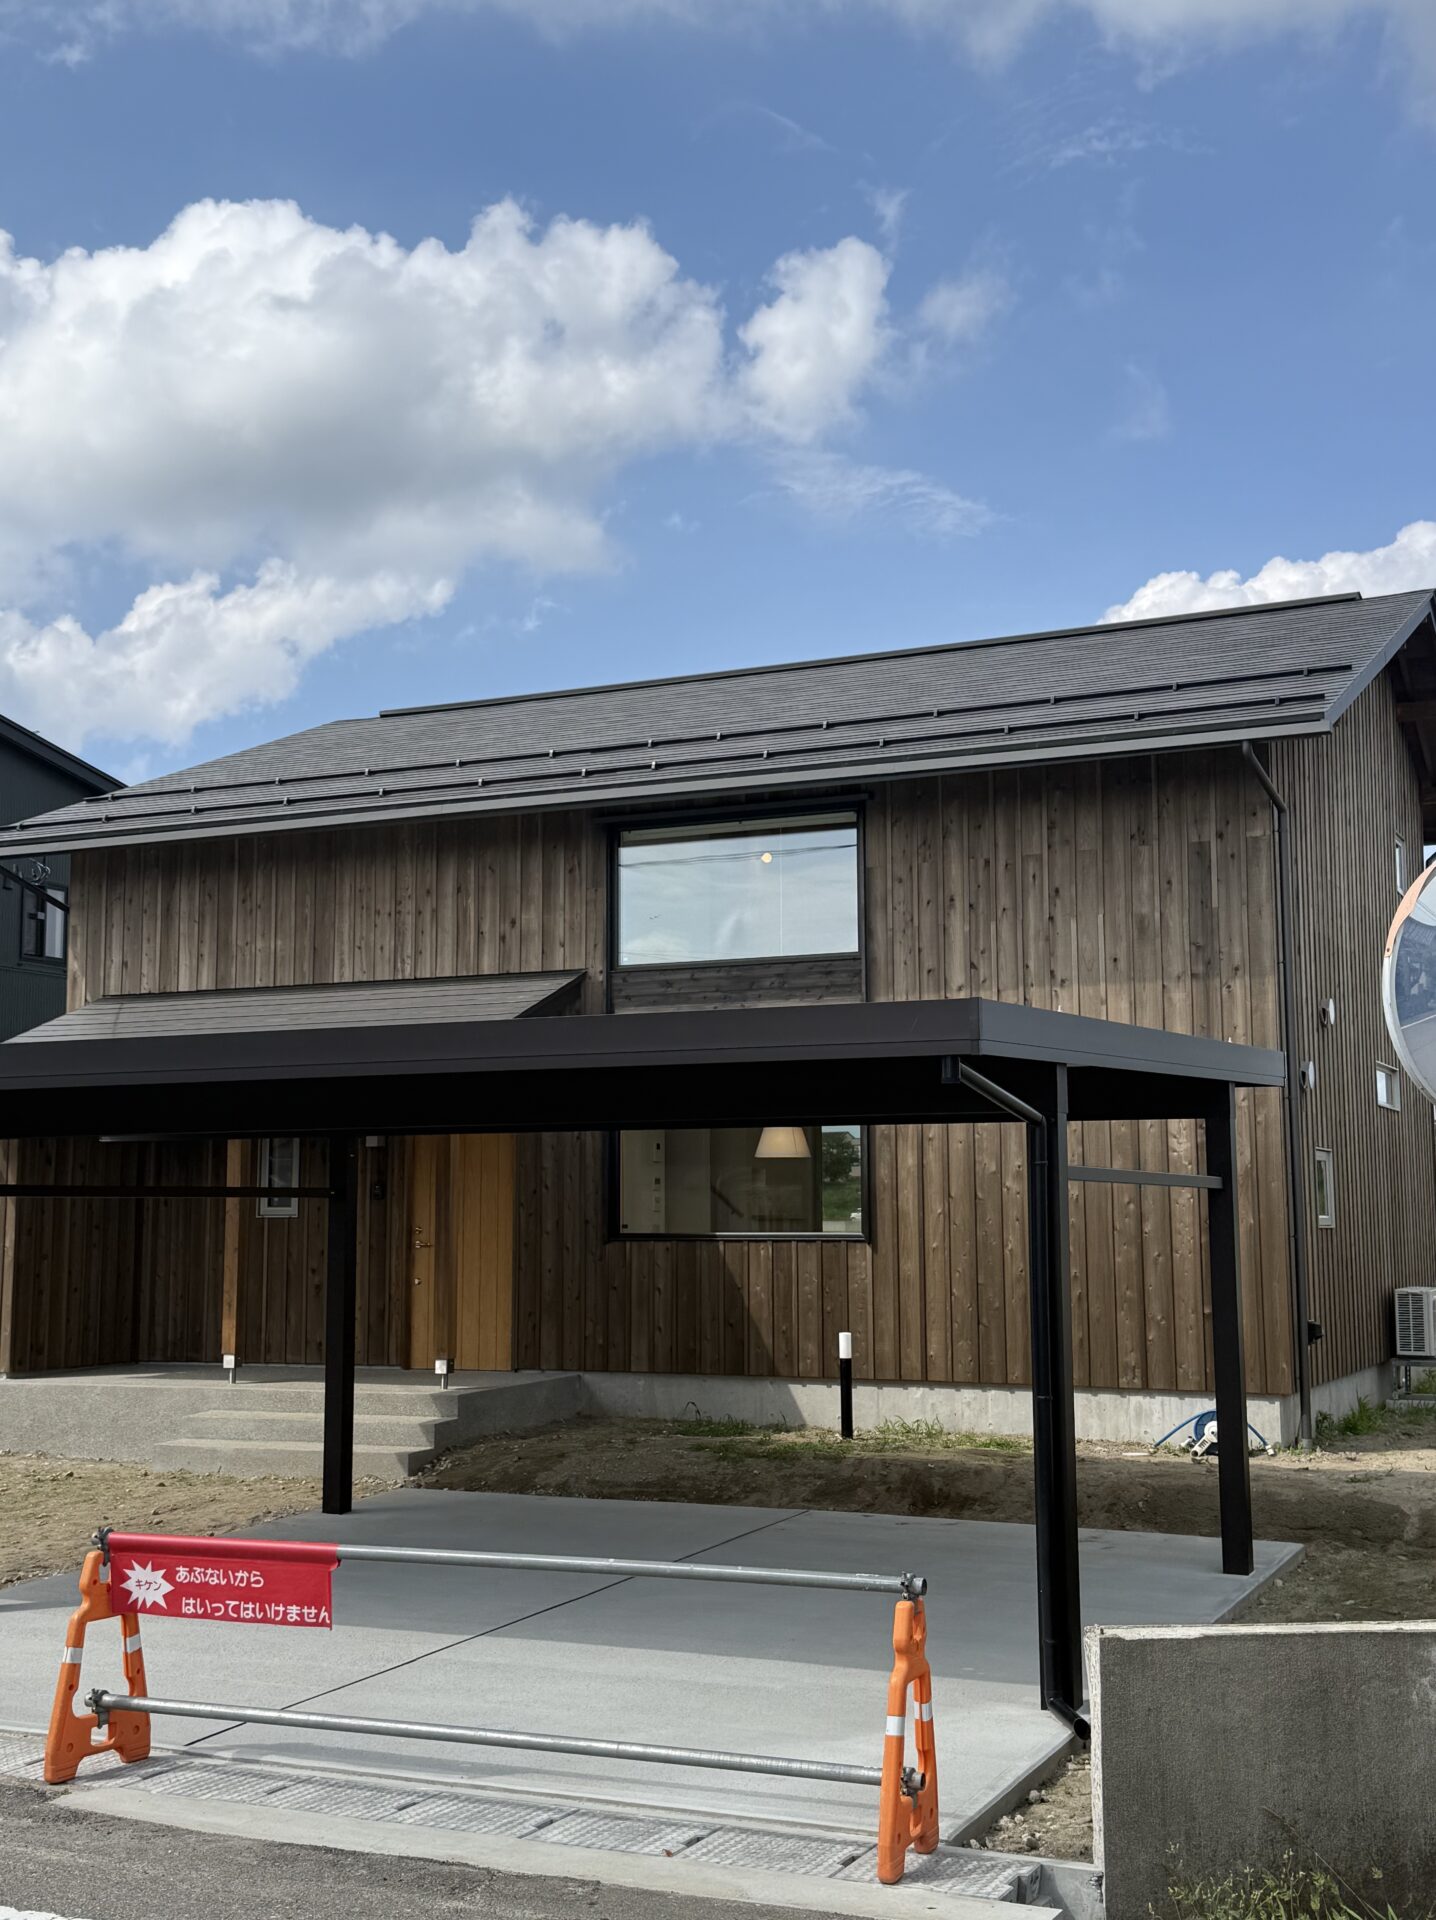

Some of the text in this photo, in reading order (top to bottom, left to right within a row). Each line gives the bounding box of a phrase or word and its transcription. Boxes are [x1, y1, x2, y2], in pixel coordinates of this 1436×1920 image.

[135, 1579, 162, 1591] キケン
[175, 1566, 265, 1588] あぶないから
[182, 1597, 331, 1624] はいってはいけません
